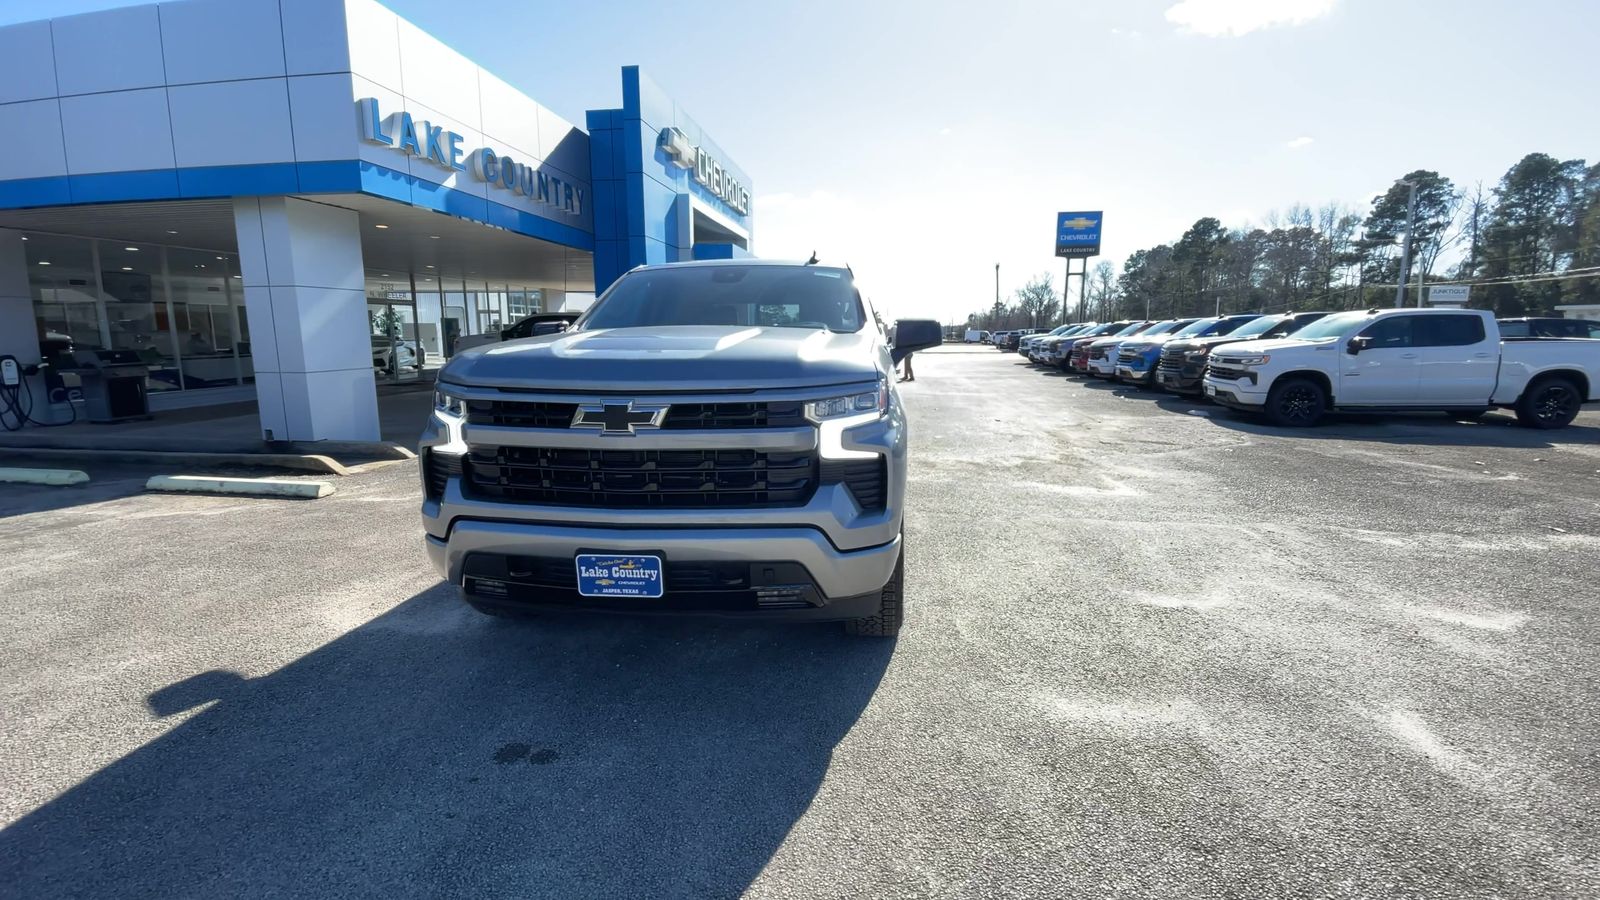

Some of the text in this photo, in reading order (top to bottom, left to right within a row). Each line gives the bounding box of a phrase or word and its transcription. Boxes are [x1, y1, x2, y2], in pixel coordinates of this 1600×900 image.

[362, 97, 585, 216] LAKE COUNTRY
[696, 146, 751, 217] CHEVROLET
[580, 566, 658, 581] Lake Country
